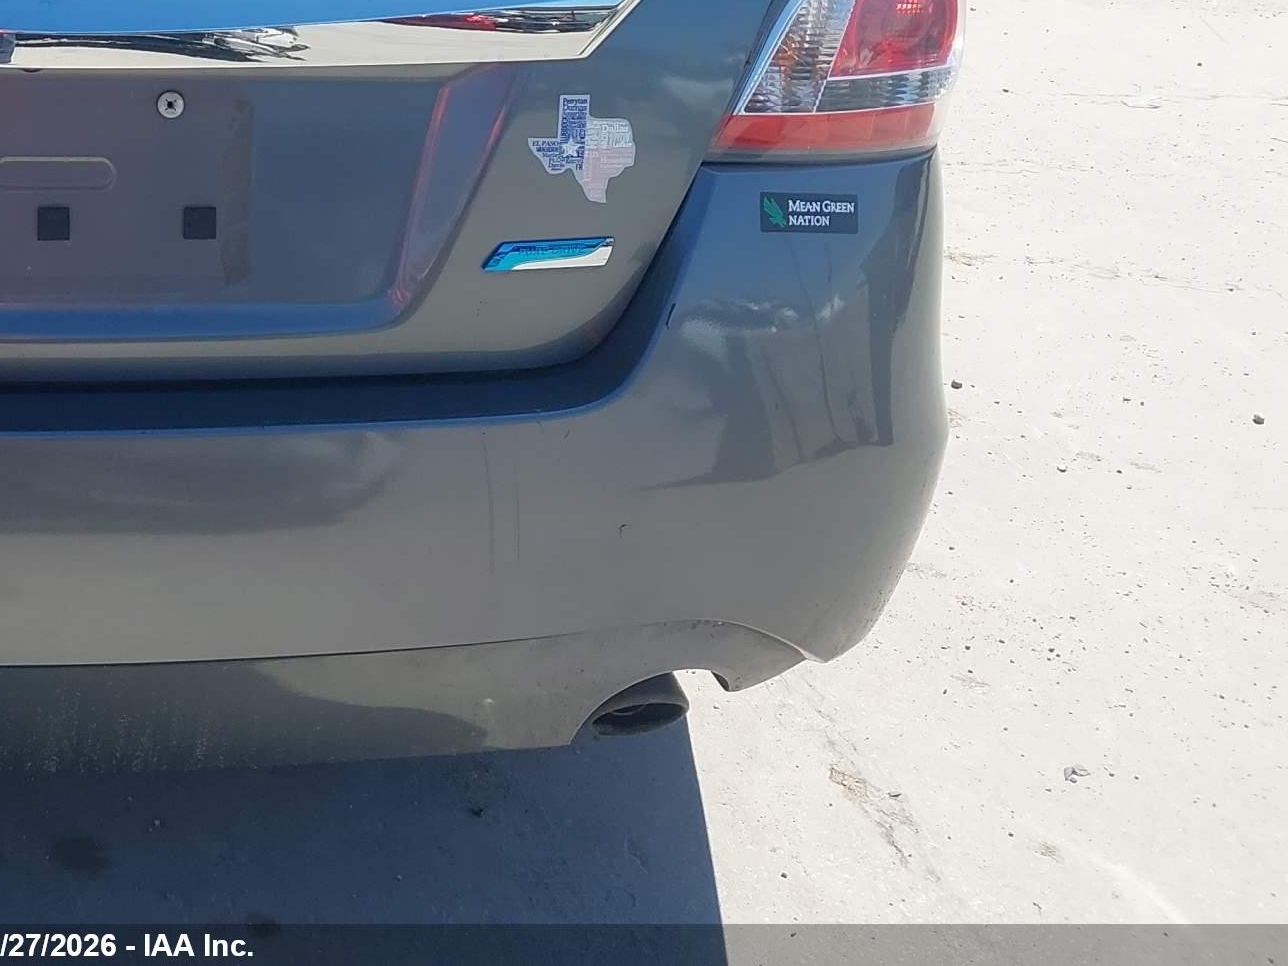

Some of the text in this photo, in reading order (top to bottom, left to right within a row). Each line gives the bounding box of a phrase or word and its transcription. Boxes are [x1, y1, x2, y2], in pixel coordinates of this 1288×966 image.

[788, 200, 855, 213] MEAN GREEN
[788, 215, 830, 226] NATION
